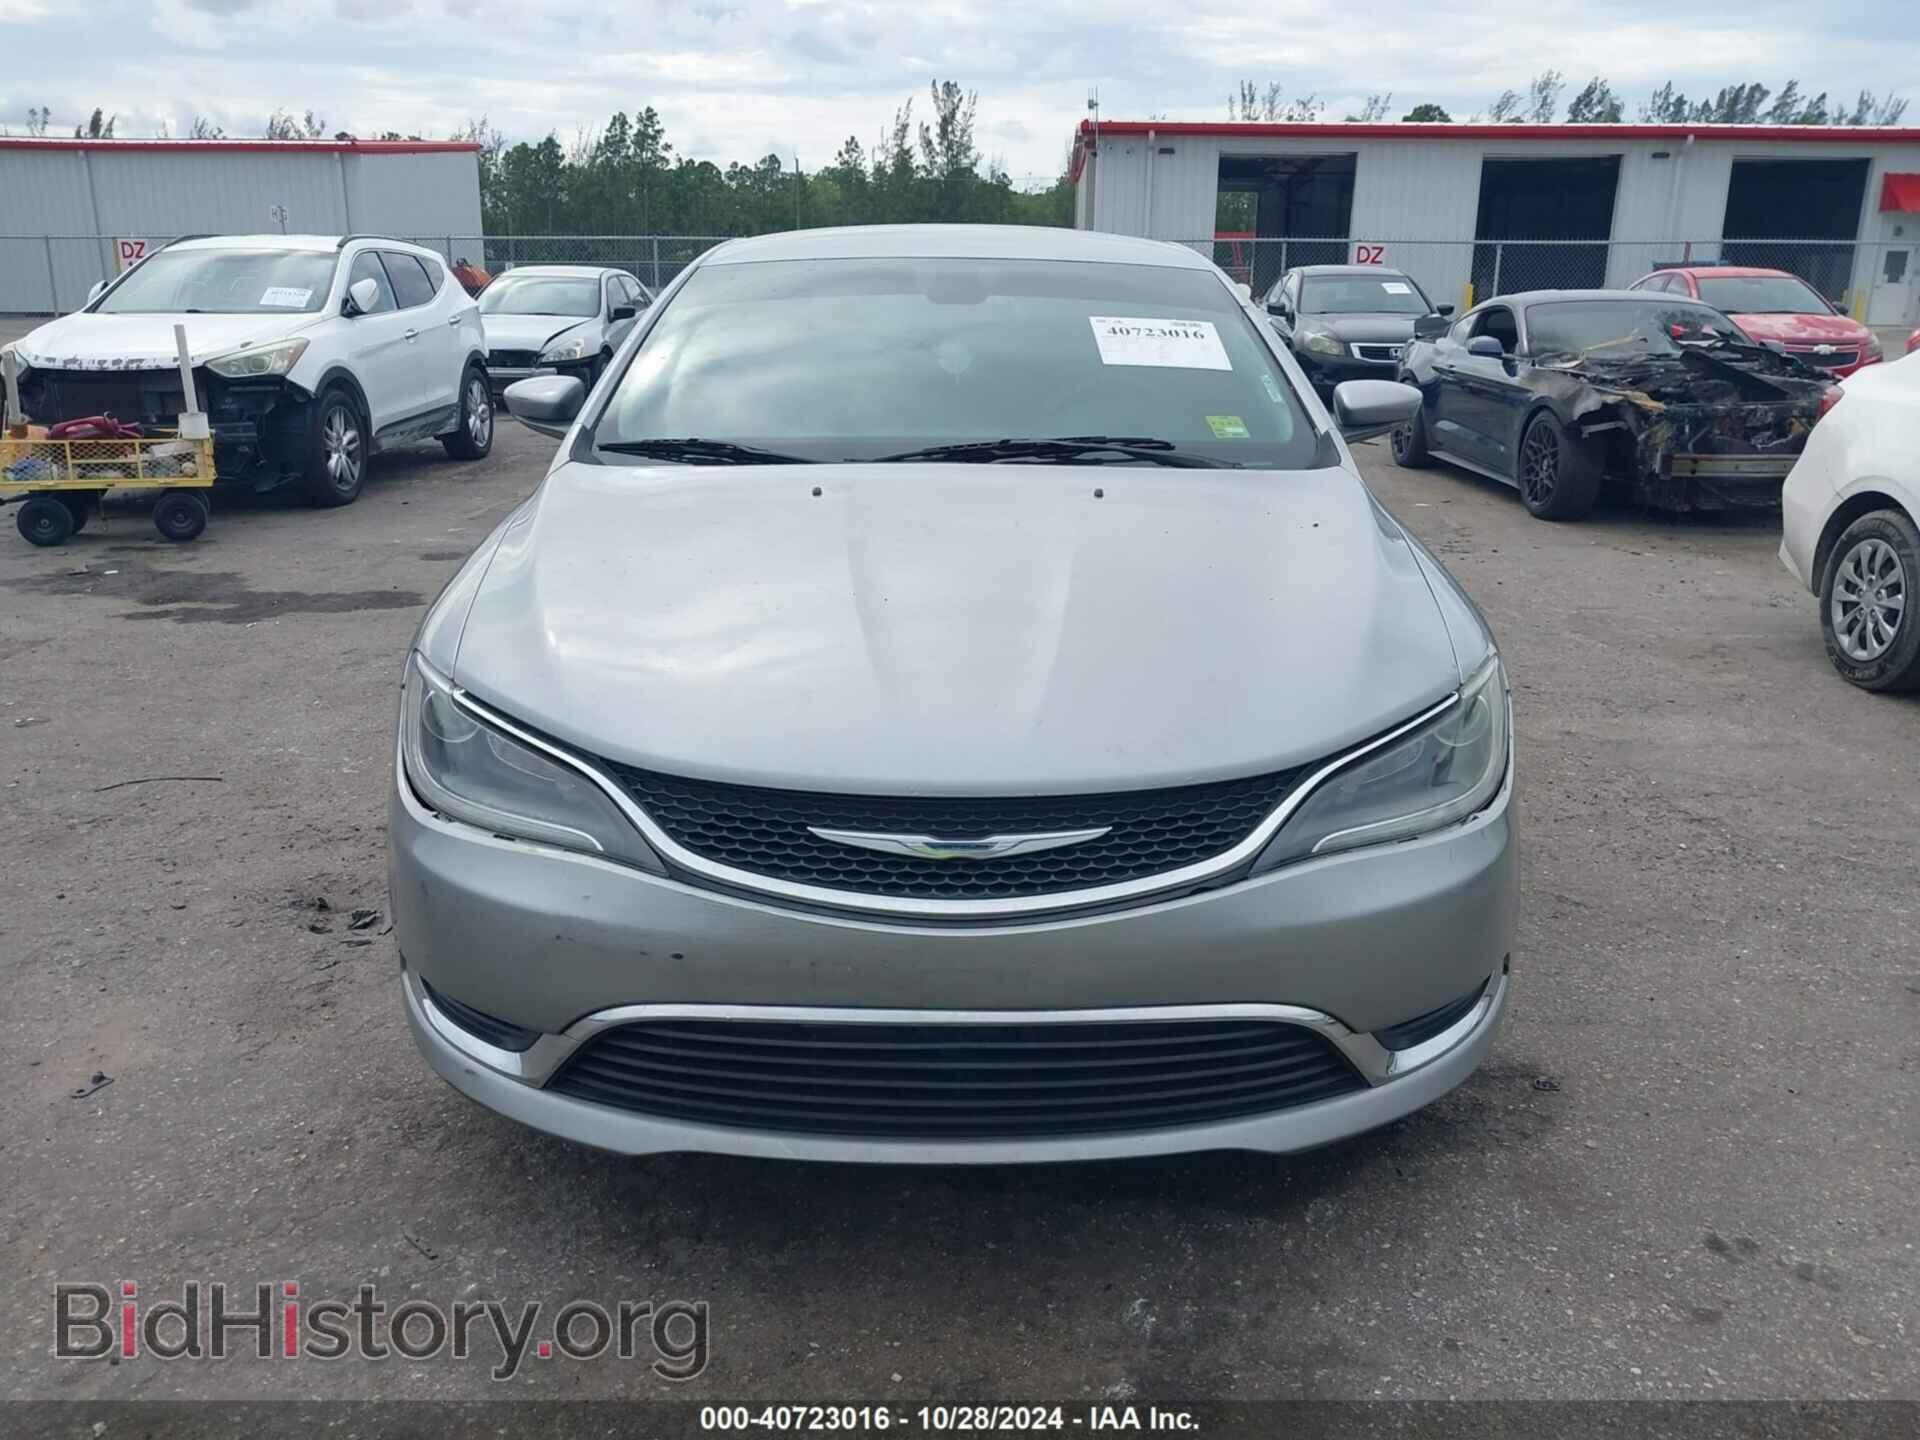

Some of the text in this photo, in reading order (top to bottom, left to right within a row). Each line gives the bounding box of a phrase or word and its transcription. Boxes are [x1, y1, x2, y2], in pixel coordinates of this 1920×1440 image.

[121, 241, 145, 259] DZ
[1357, 246, 1384, 264] DZ
[1106, 325, 1206, 340] 40723016
